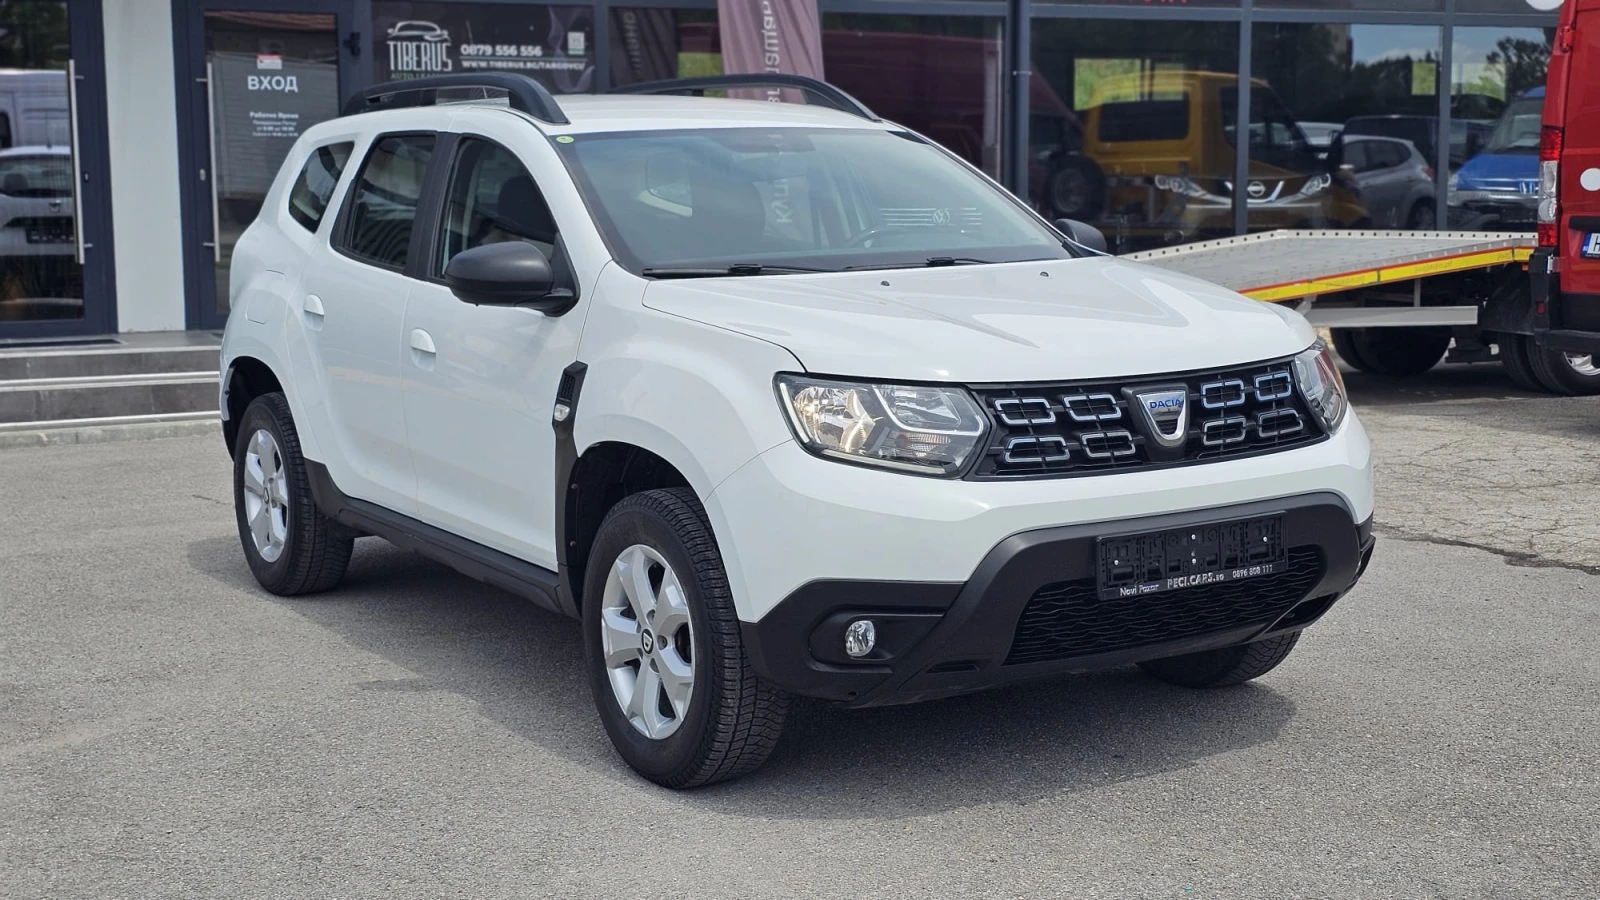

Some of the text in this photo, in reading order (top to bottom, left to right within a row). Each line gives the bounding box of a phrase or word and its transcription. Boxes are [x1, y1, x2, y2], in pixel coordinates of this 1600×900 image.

[386, 40, 452, 72] TIBERUS
[460, 44, 543, 57] 0879 556 556
[390, 72, 414, 80] AUTO
[247, 75, 298, 93] ВХОД
[1149, 399, 1183, 409] DACIA
[1120, 585, 1137, 597] Novi
[1232, 568, 1248, 579] 0896
[1249, 566, 1261, 576] 808
[1262, 564, 1273, 574] 111
